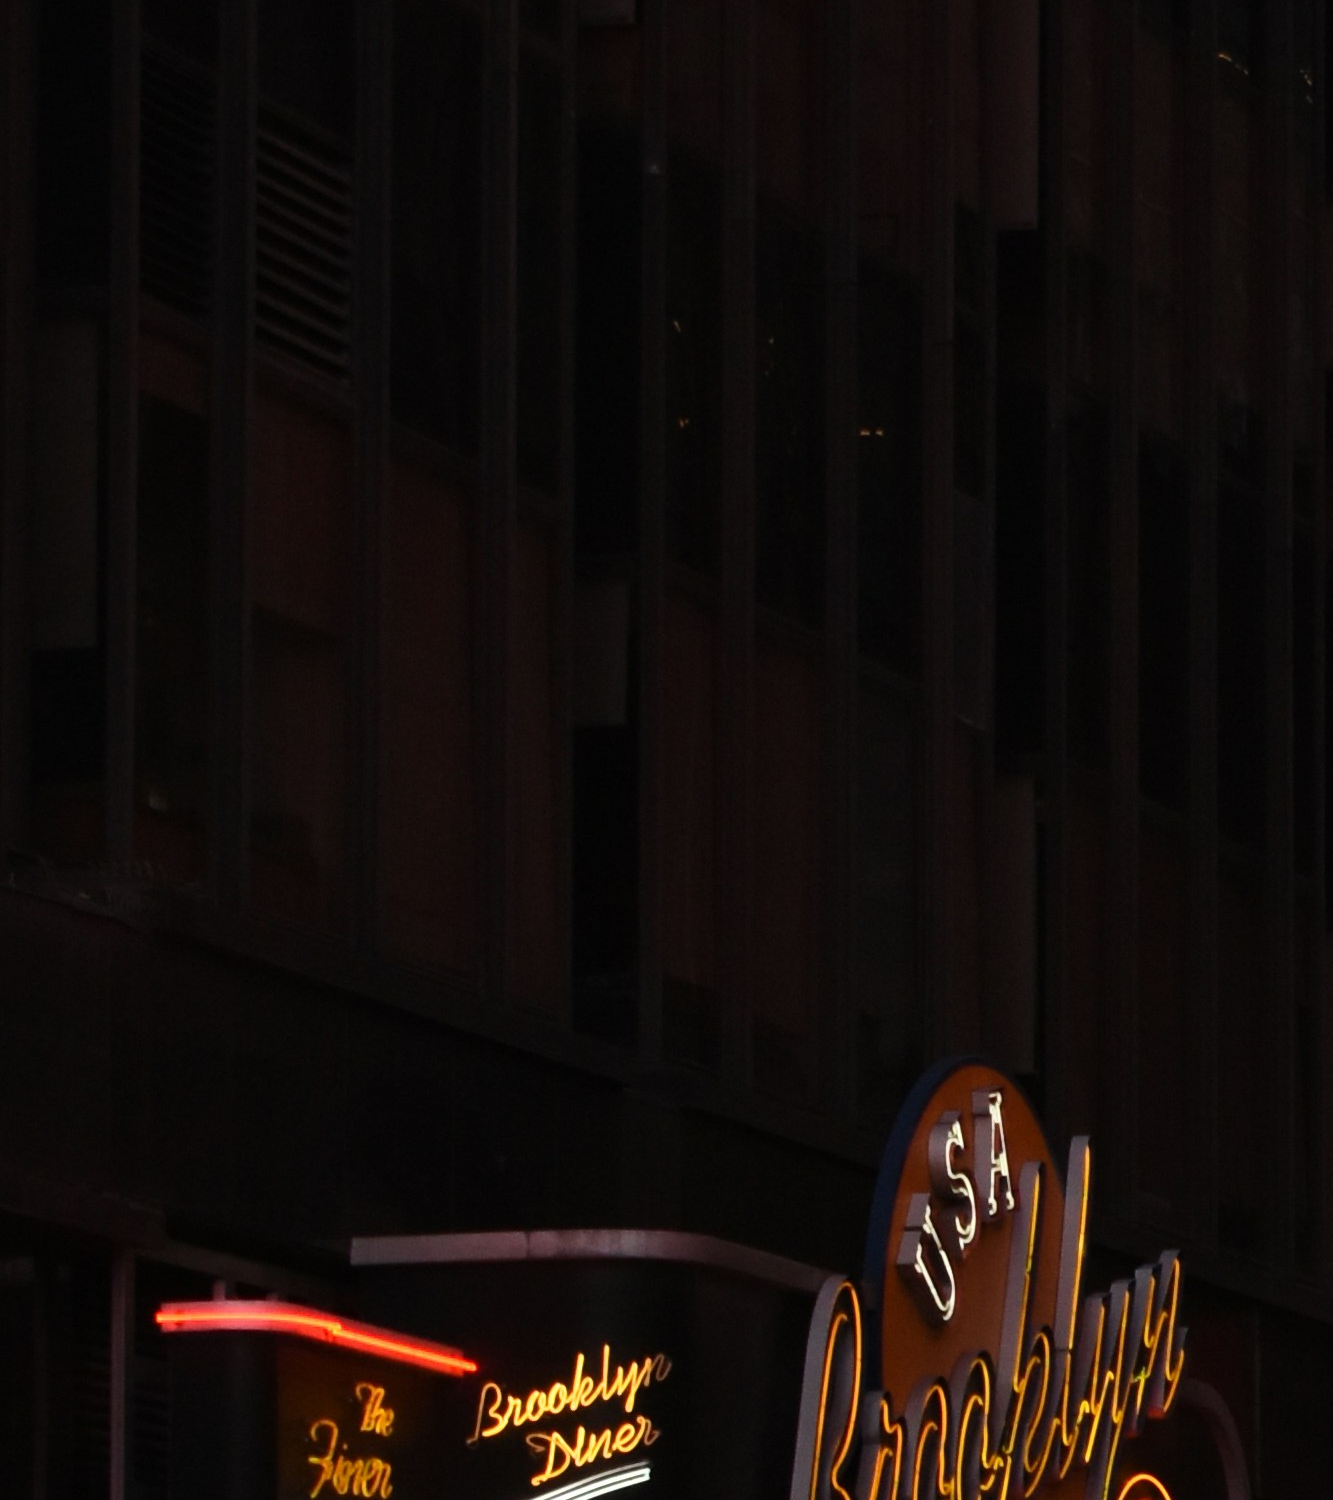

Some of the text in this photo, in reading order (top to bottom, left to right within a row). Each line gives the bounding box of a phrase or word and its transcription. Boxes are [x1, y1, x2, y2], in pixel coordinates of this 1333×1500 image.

[896, 1088, 1015, 1322] USA
[355, 1382, 395, 1437] The
[465, 1344, 673, 1448] Brooklyn
[526, 1414, 661, 1487] Diner
